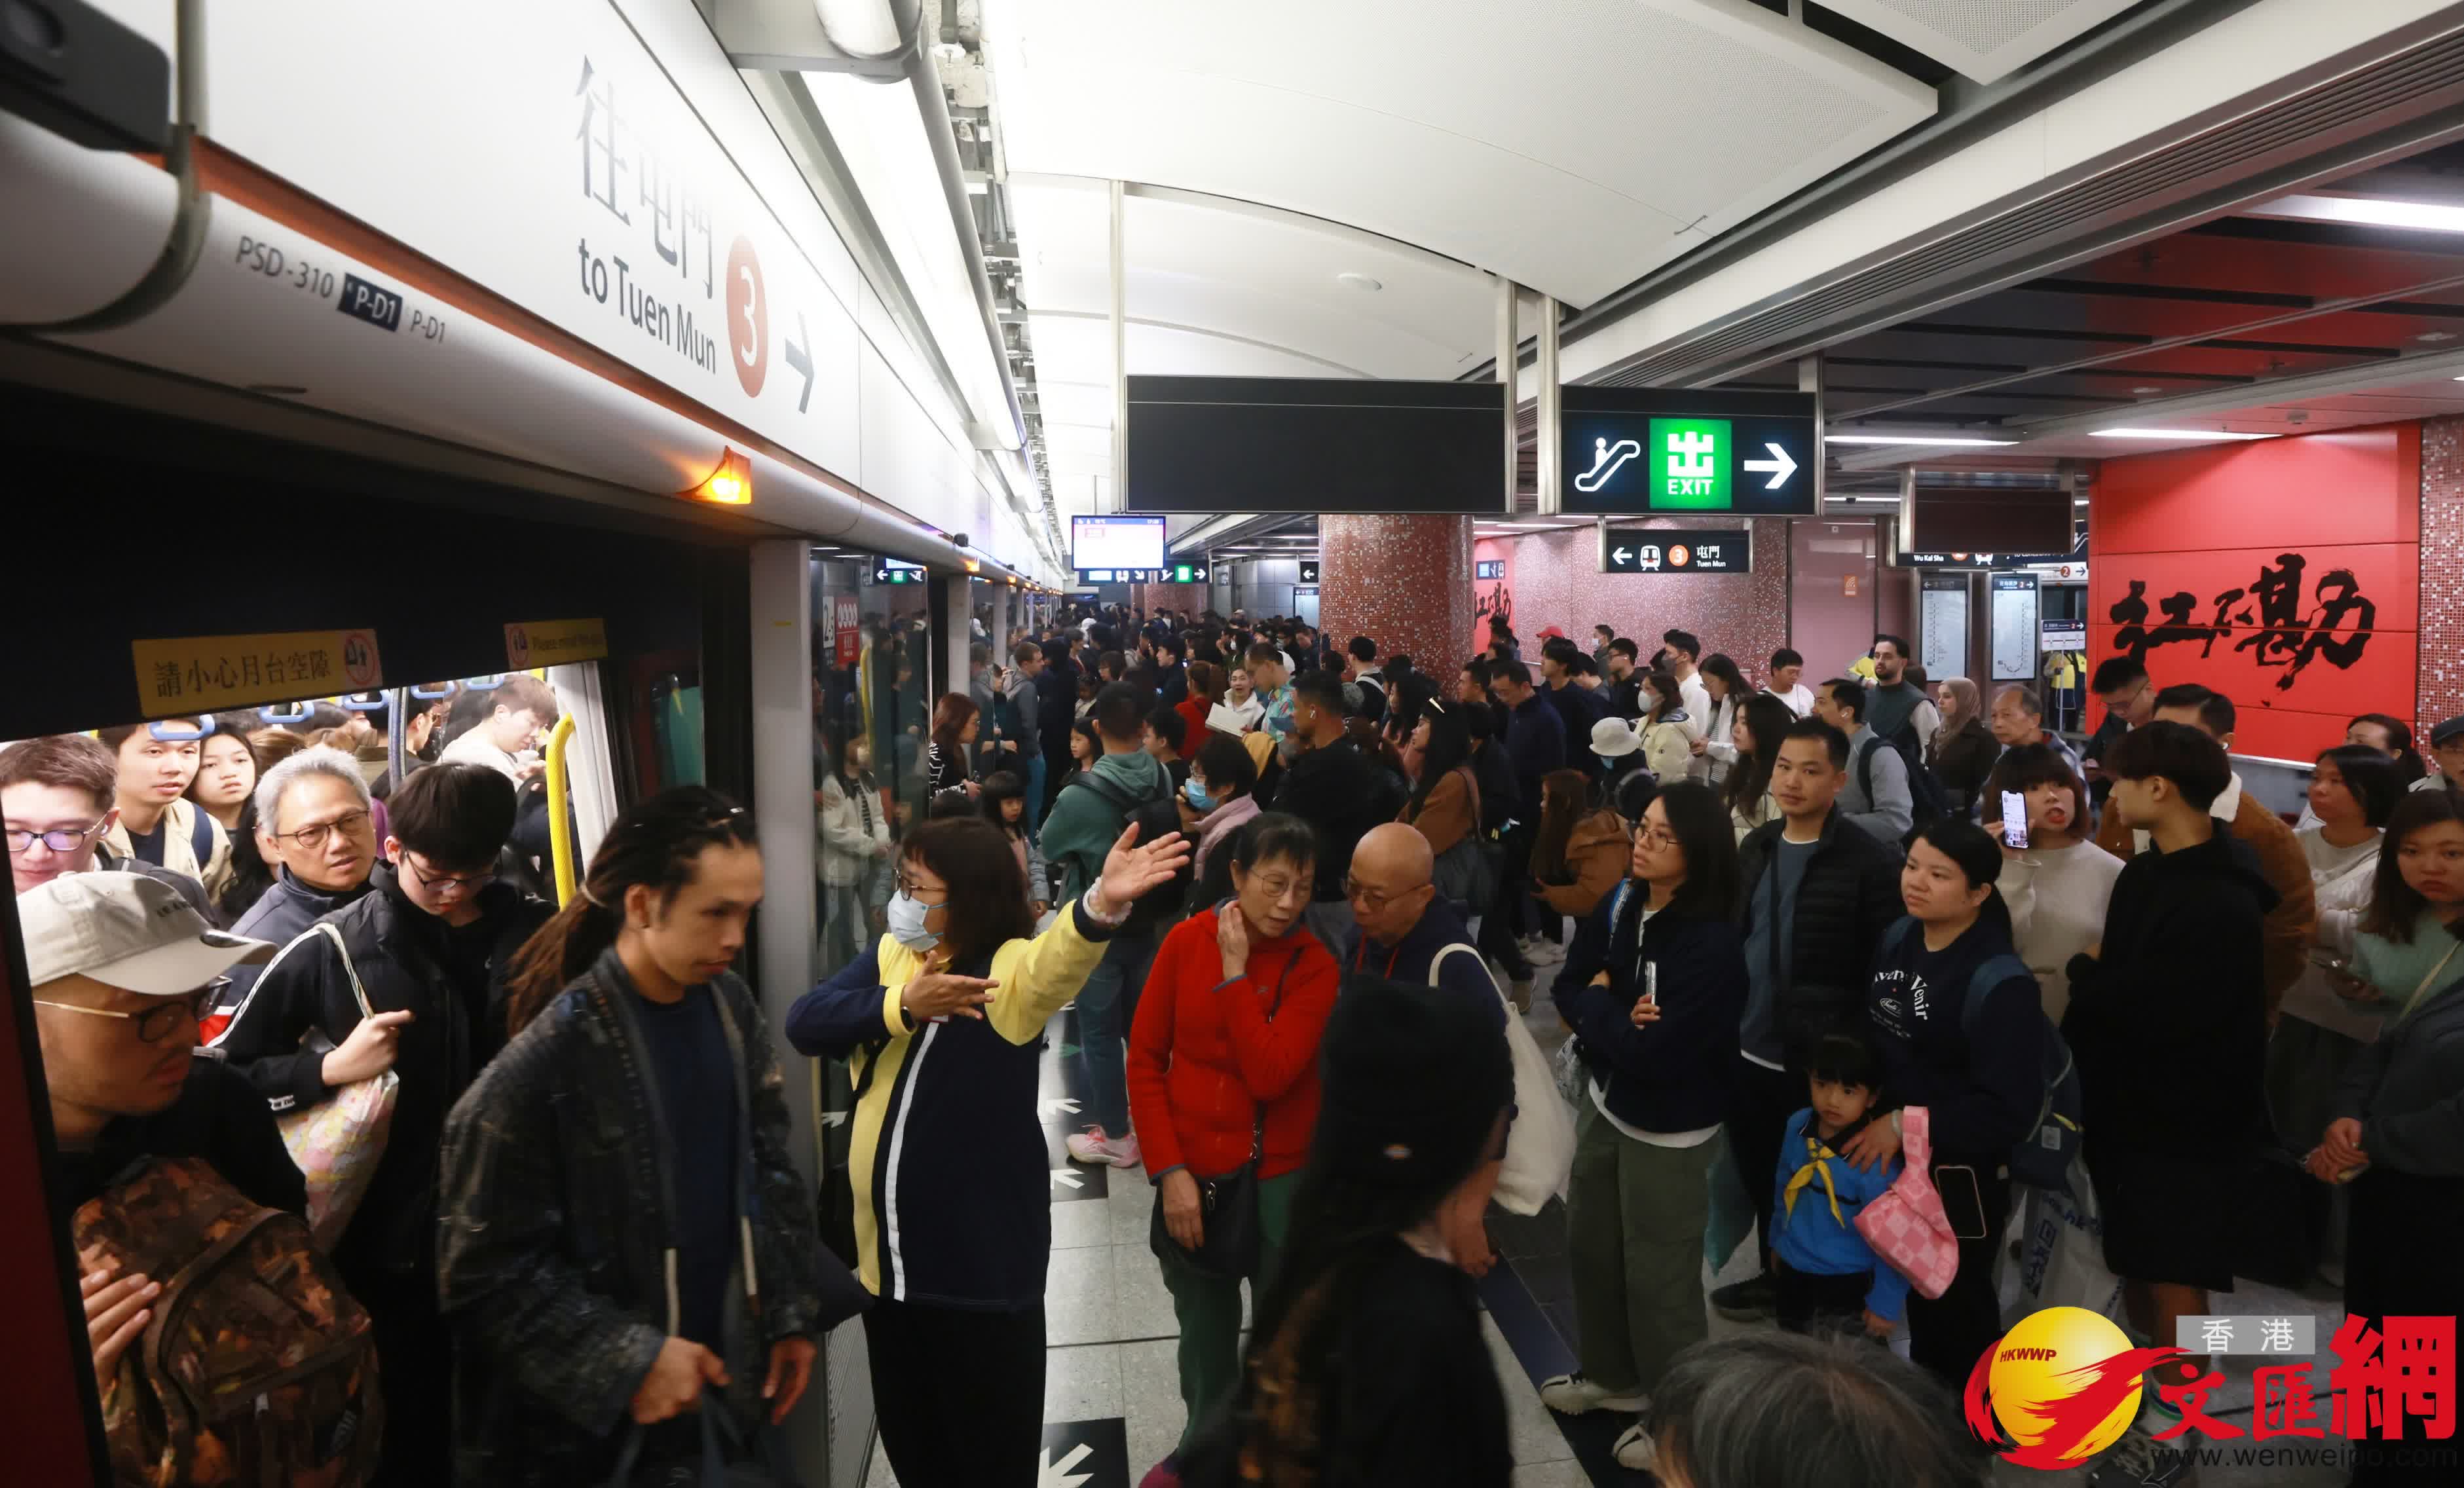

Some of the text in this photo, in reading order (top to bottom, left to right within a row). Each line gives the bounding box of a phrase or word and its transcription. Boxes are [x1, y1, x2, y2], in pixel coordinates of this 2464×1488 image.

[575, 54, 713, 299] 往屯門
[236, 236, 445, 343] PSD-310 P-D1 P-D1
[578, 238, 717, 374] to Tuen Mun
[1667, 431, 1714, 477] 出
[1668, 479, 1713, 495] EXIT
[1696, 545, 1720, 559] 屯門
[2110, 553, 2376, 693] 紅磡
[153, 649, 331, 698] 請小心月台空隙
[1911, 974, 1930, 1021] Venir
